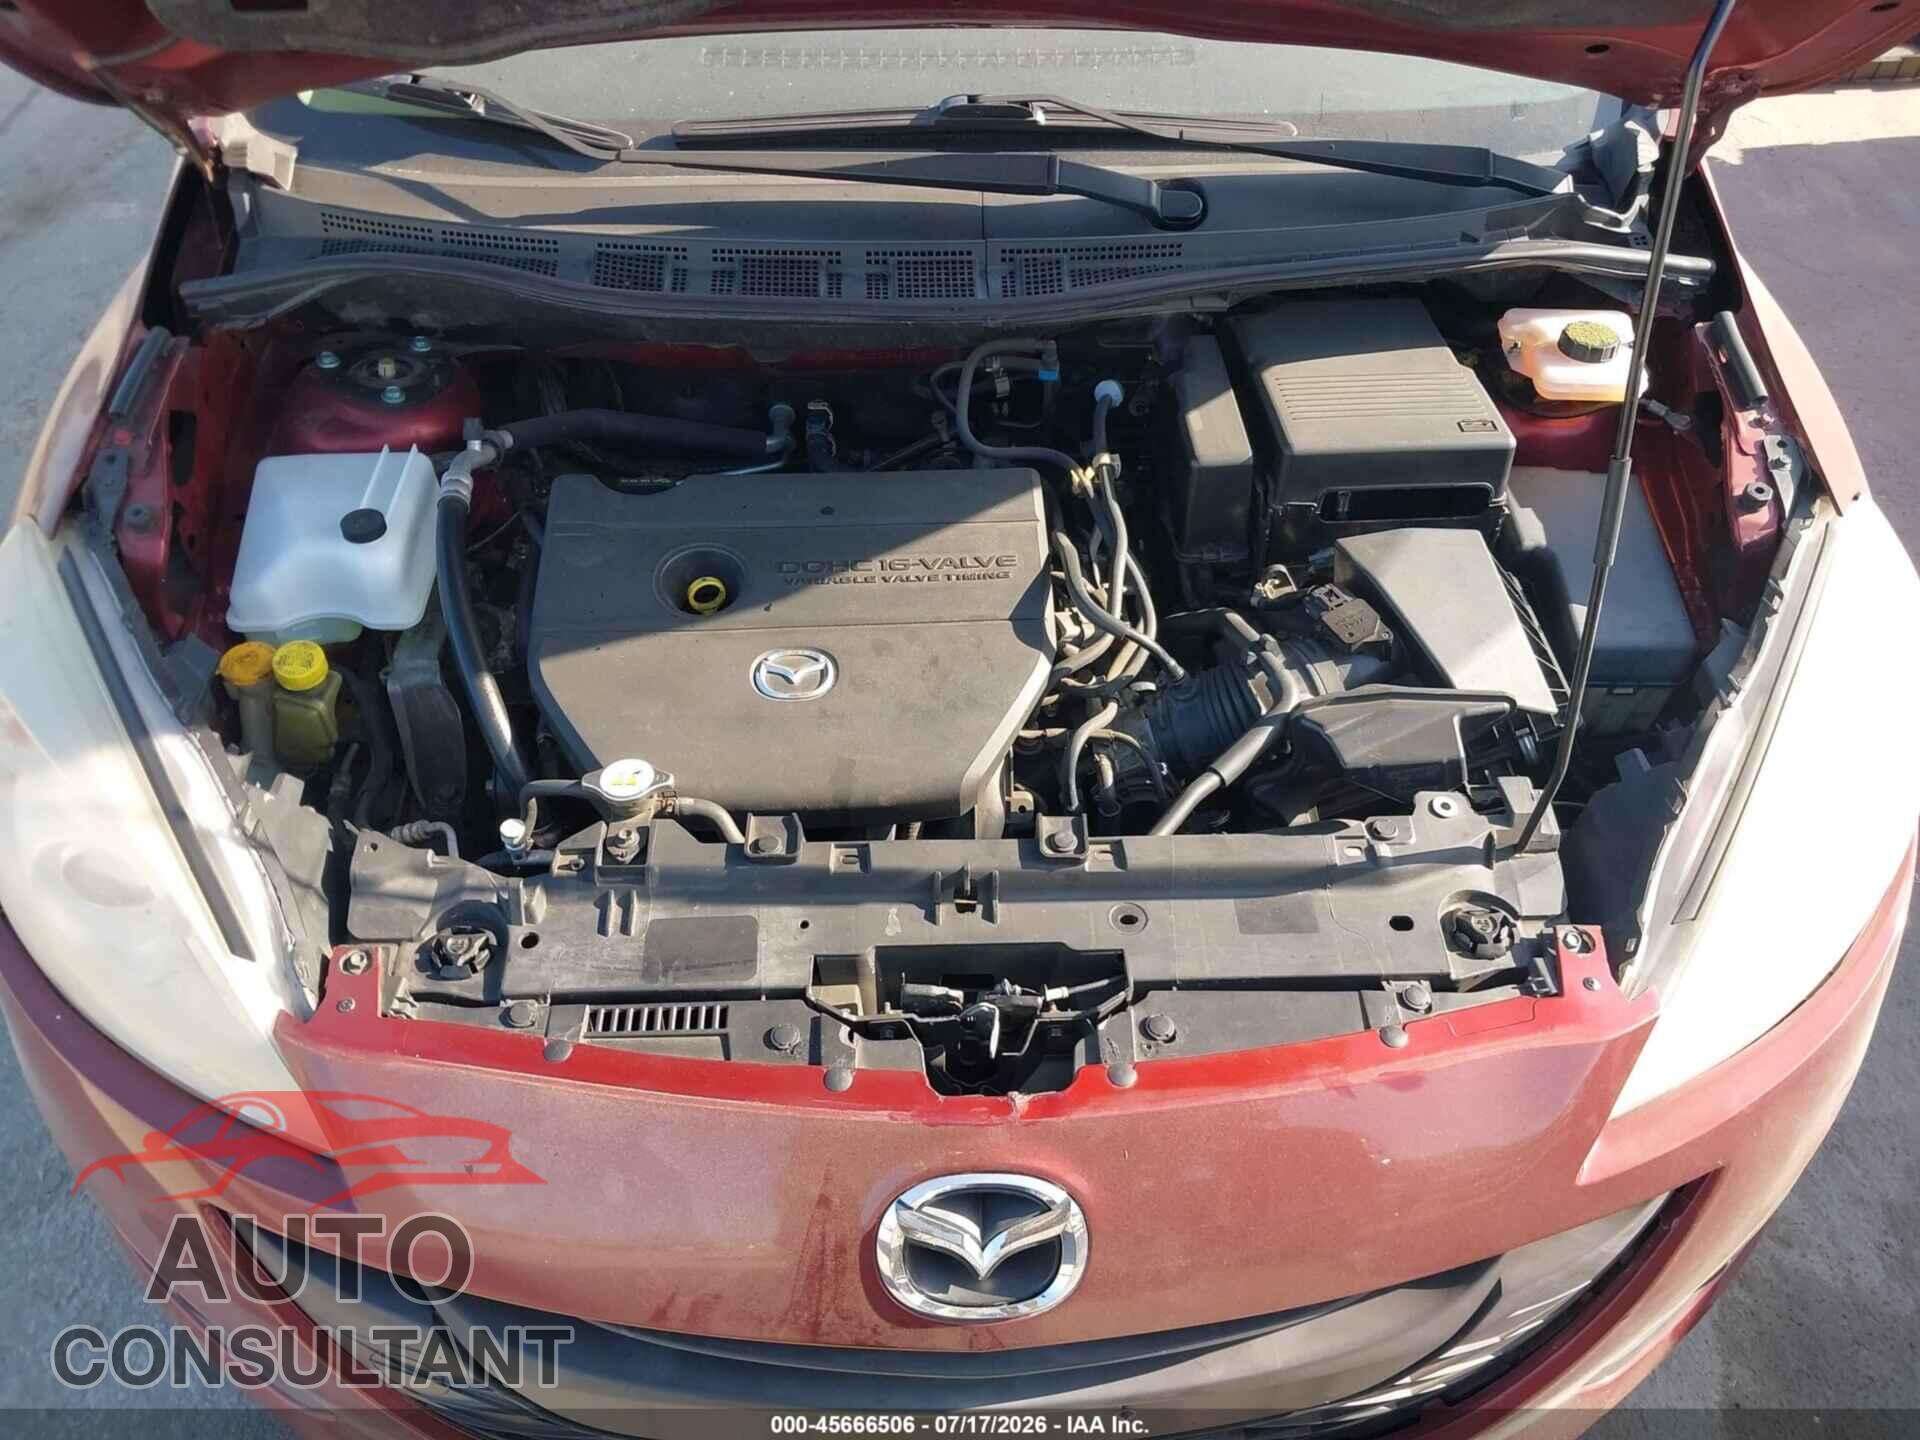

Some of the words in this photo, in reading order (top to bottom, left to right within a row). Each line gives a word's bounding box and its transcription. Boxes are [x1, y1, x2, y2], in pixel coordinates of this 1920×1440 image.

[879, 555, 1018, 572] 16-VALVE
[880, 572, 940, 584] VALVE
[943, 570, 1011, 583] TIMING
